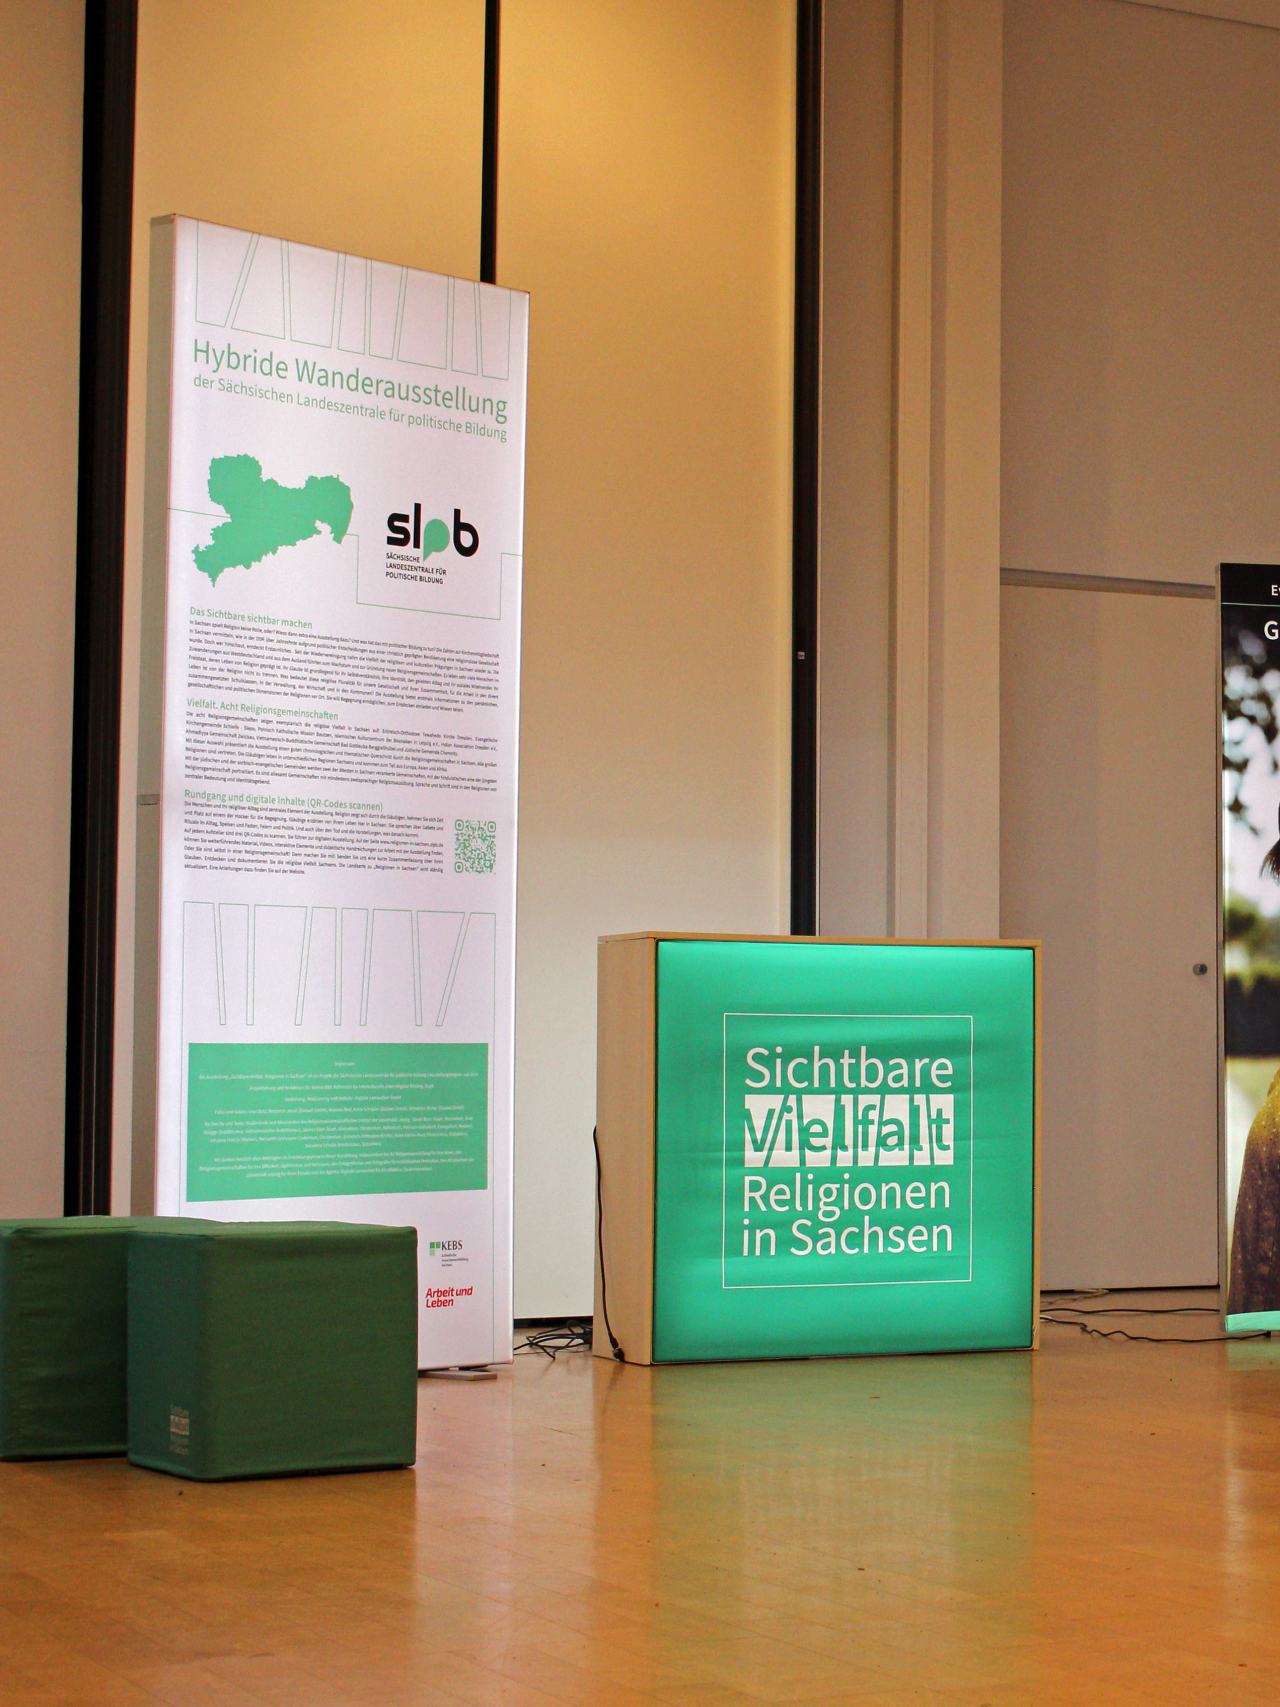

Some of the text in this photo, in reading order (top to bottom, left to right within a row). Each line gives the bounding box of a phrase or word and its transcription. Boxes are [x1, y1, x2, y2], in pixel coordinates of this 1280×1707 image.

[194, 339, 508, 424] Hybride Wanderausstellung
[193, 374, 508, 443] der Sächsischen Landeszentrale für politische Bildung
[386, 562, 435, 575] LANDESZENTRALE
[386, 571, 444, 585] POLITISCHE BILDUNG
[190, 606, 313, 629] Das Sichtbare sichtbar machen
[186, 697, 218, 710] Vielfalt.
[220, 701, 239, 712] Acht
[240, 702, 339, 721] Religionsgemeinschaften
[184, 789, 226, 803] Rundgang
[228, 792, 244, 802] und
[246, 793, 276, 806] digitale
[350, 802, 384, 812] scannen)
[744, 1045, 954, 1089] Sichtbare
[744, 1096, 953, 1161] Vielfalt
[744, 1172, 950, 1222] Religionen
[441, 1240, 463, 1251] KEBS
[742, 1215, 952, 1256] in Sachsen
[425, 1286, 474, 1299] Arbeit und
[425, 1298, 454, 1308] Leben
